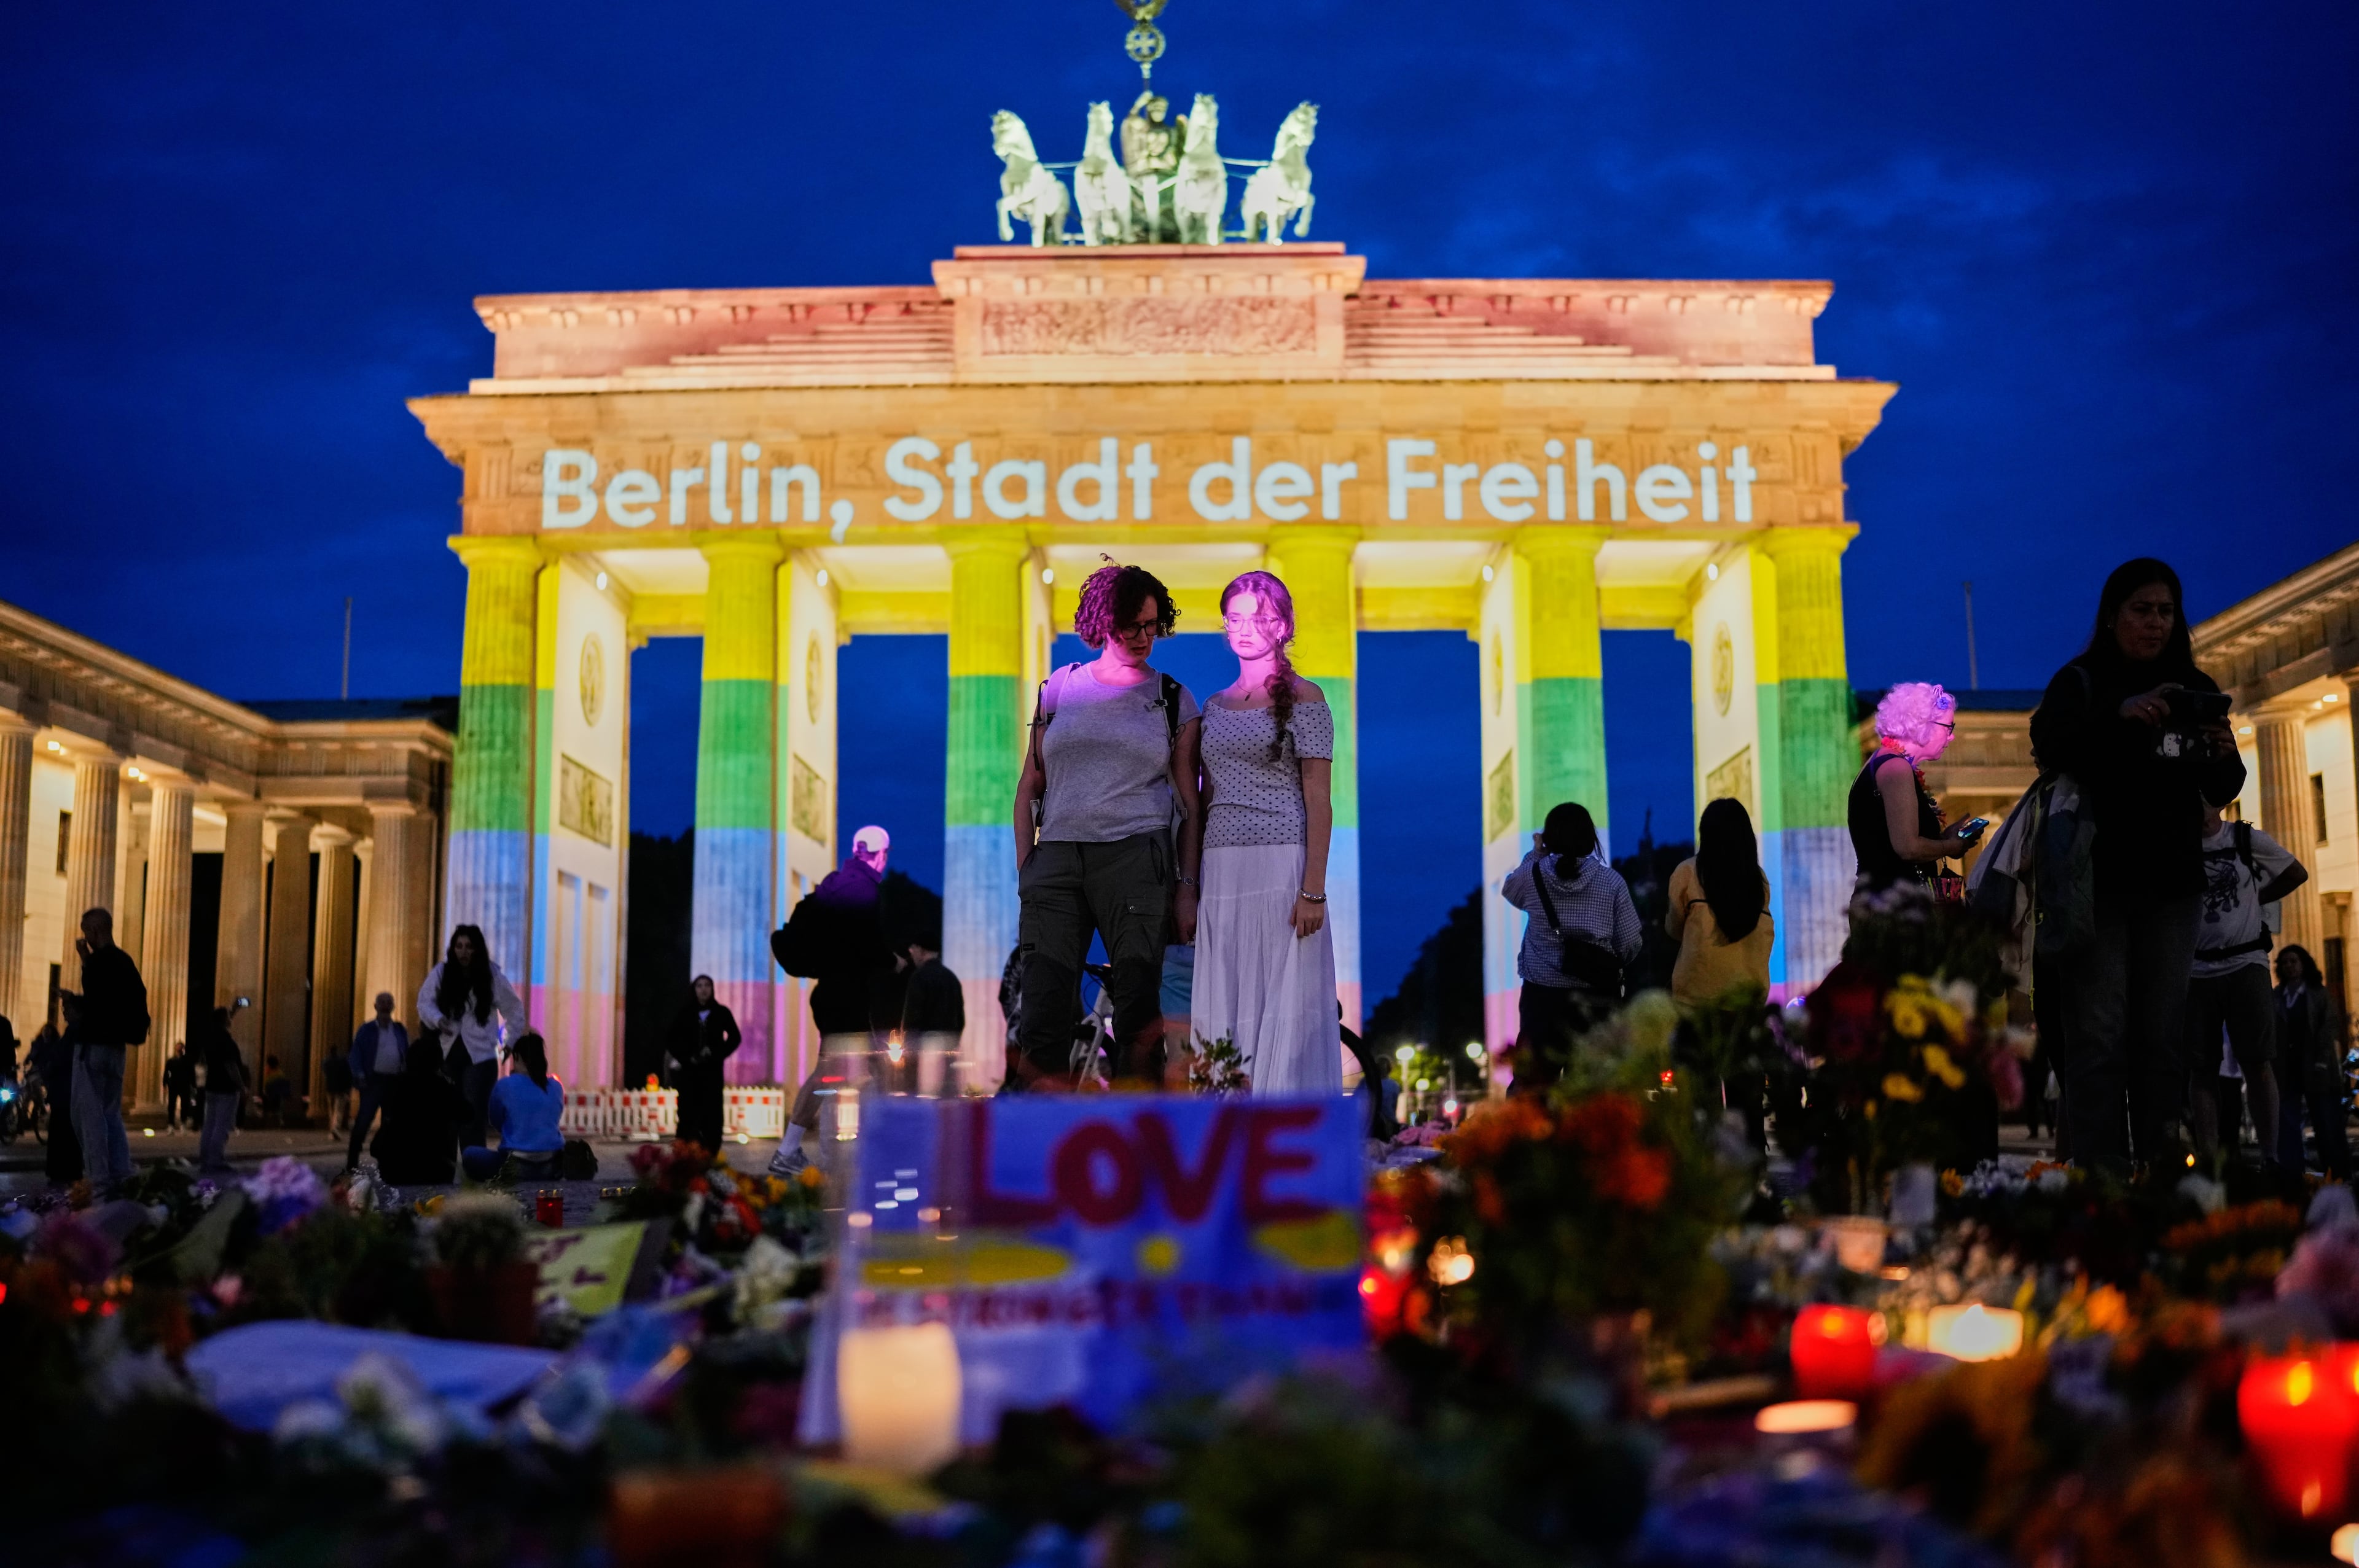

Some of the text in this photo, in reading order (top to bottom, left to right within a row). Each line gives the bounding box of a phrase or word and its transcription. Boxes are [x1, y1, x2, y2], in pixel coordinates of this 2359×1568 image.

[542, 436, 1756, 544] Berlin, Stadt der Freiheit
[969, 1104, 1326, 1227] LOVE
